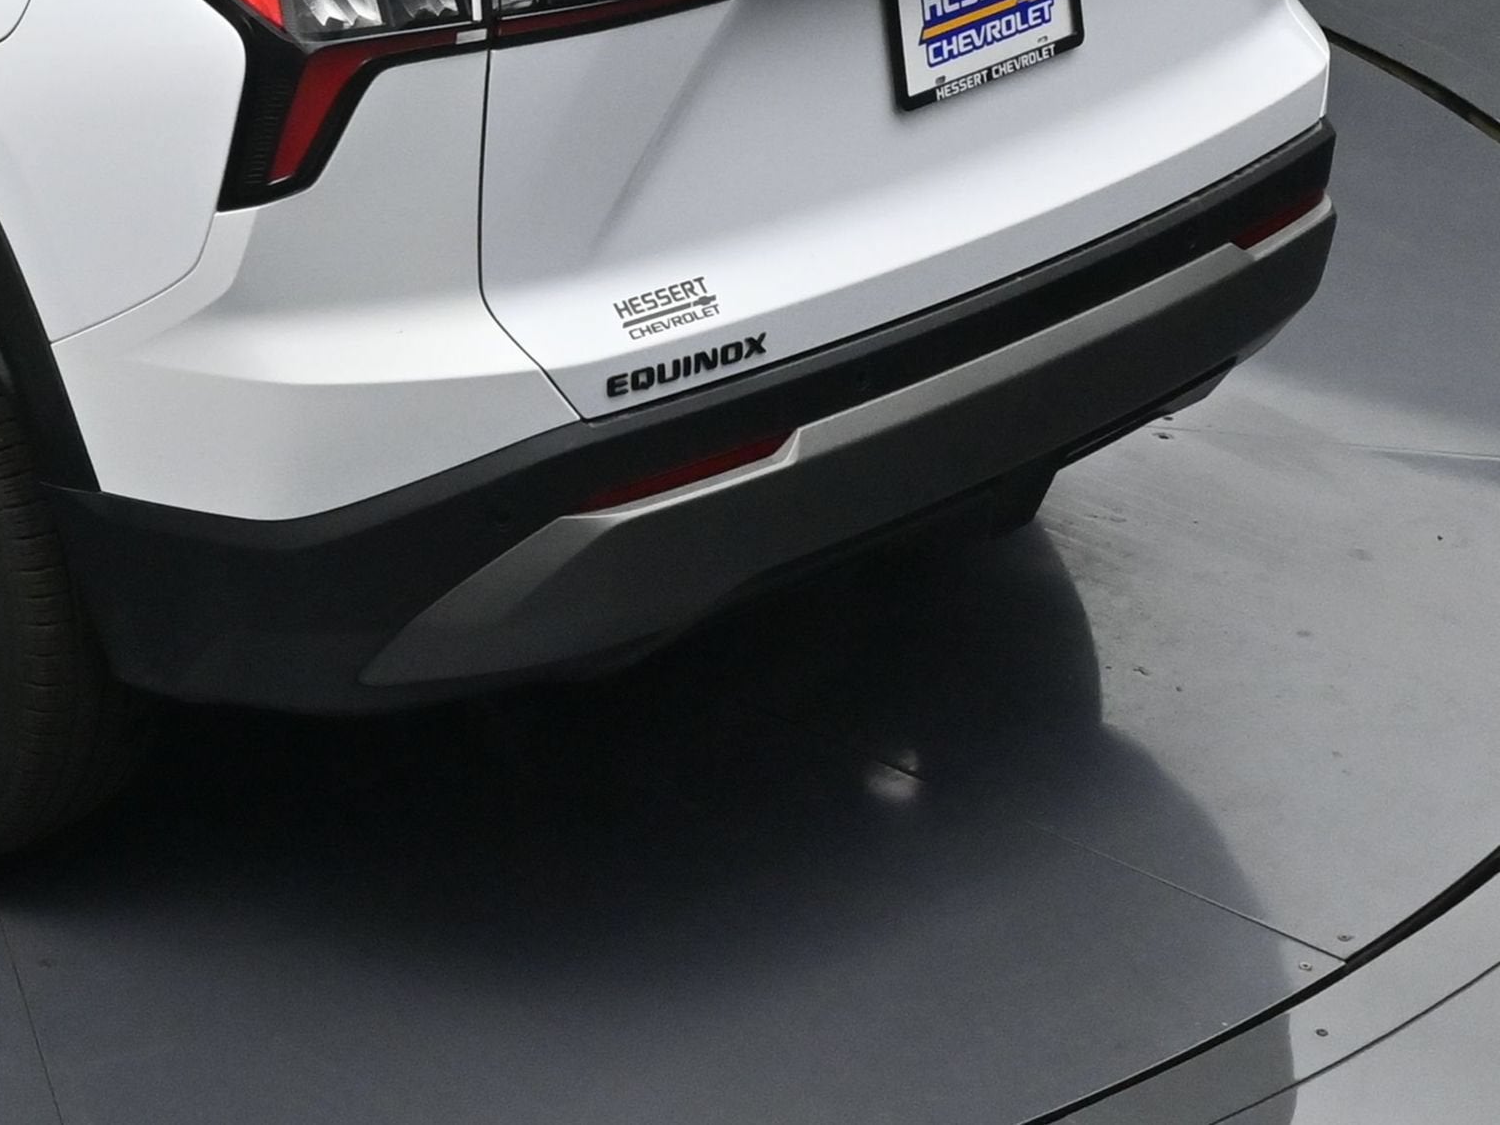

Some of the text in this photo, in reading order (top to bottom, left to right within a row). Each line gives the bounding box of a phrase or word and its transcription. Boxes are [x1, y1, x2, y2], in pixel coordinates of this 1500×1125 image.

[927, 0, 1054, 66] CHEVROLET
[936, 44, 1055, 101] HESSERT CHEVROLET
[613, 277, 708, 319] HESSERT
[628, 304, 720, 340] CHEVROLET
[606, 332, 766, 397] EQUINOX
